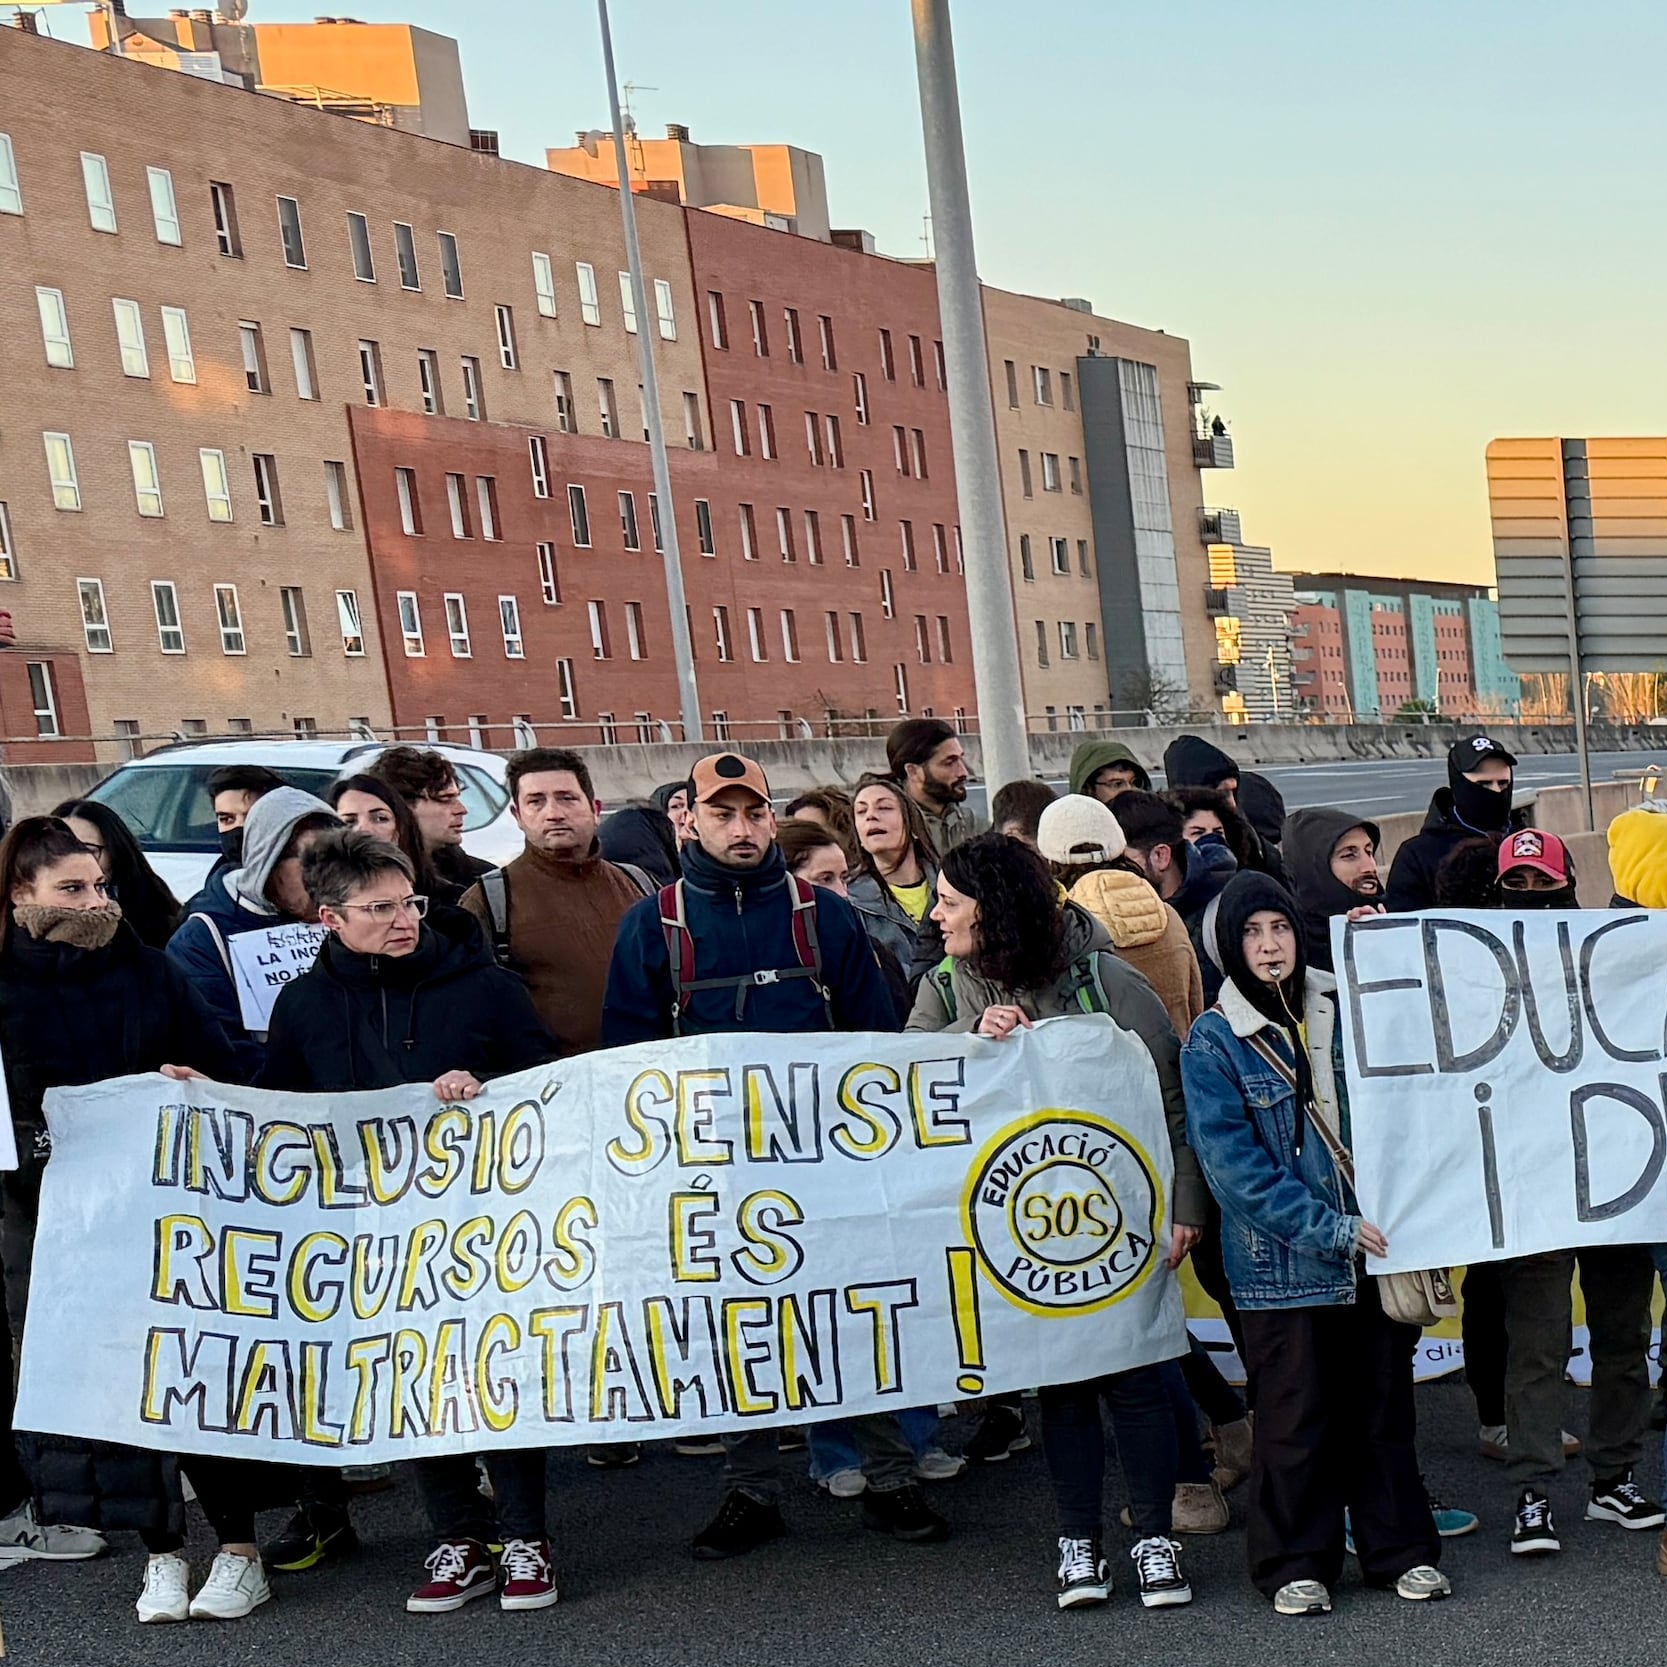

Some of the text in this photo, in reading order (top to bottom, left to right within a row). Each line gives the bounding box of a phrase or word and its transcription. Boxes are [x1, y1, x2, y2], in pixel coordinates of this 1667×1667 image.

[257, 952, 283, 967] LA
[264, 970, 292, 986] NO
[152, 1056, 972, 1209] INCLUSIÓ SENSE
[982, 1132, 1118, 1209] EDUCACIÓ
[151, 1173, 805, 1322] RECURSOS ÉS
[1023, 1193, 1110, 1241] SOS
[1006, 1231, 1150, 1296] PÚBLICA
